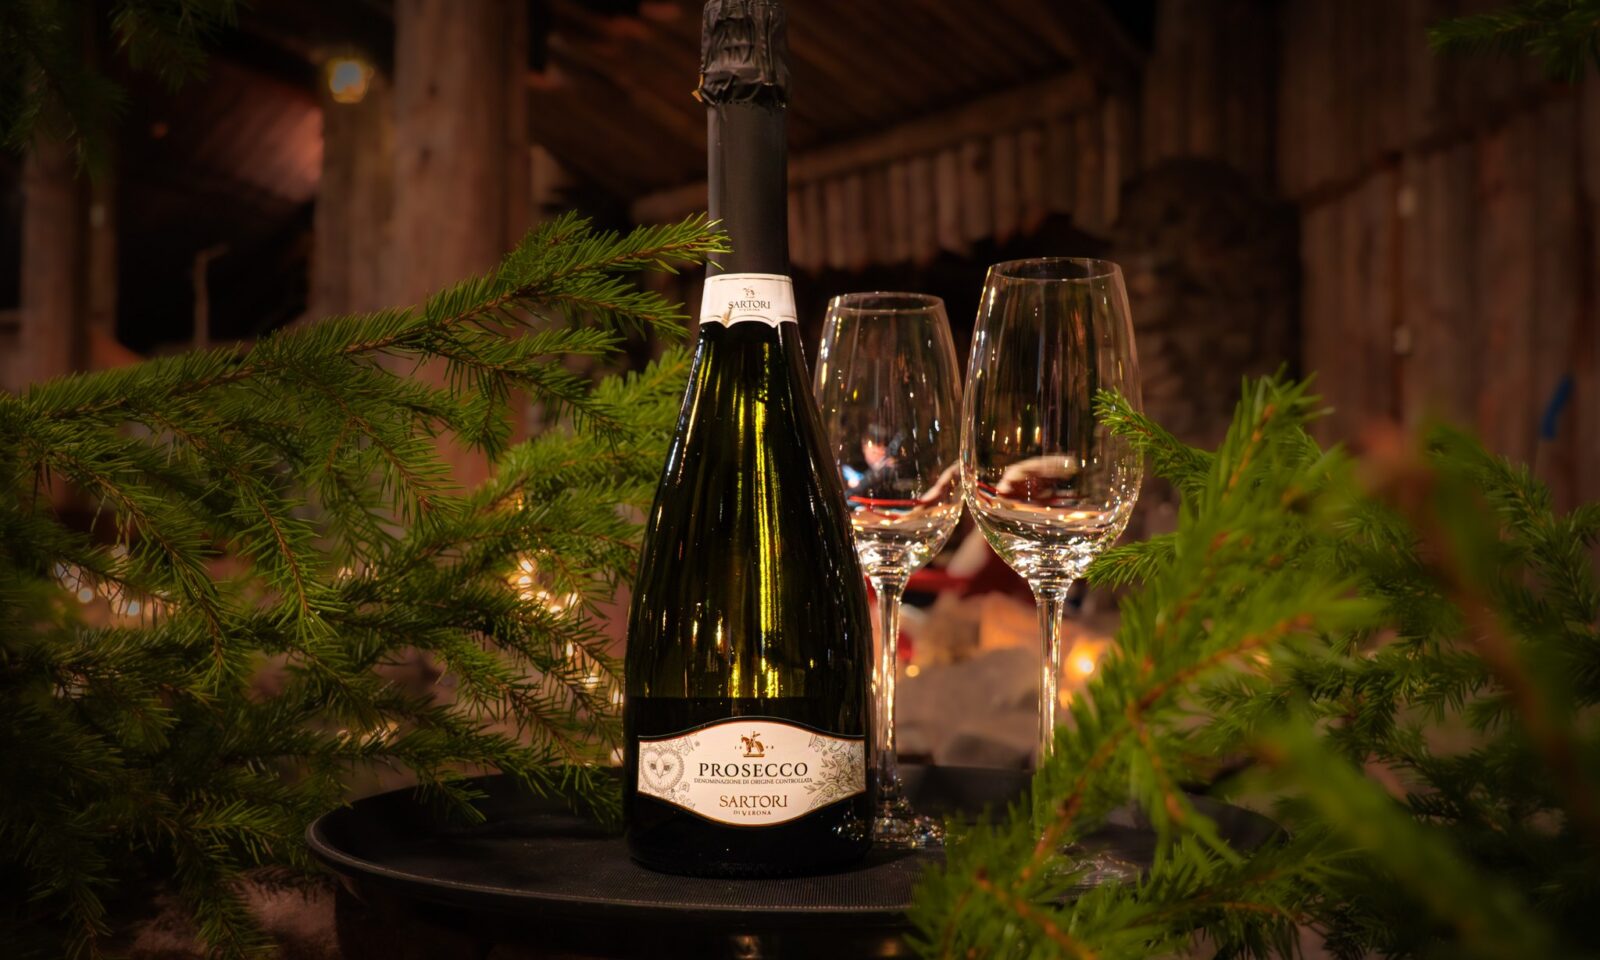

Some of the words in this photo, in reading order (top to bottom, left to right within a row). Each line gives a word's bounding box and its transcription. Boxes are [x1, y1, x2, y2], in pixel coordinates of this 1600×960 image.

[728, 300, 771, 310] SARTORI
[699, 762, 808, 777] PROSECCO
[719, 795, 788, 808] SARTORI
